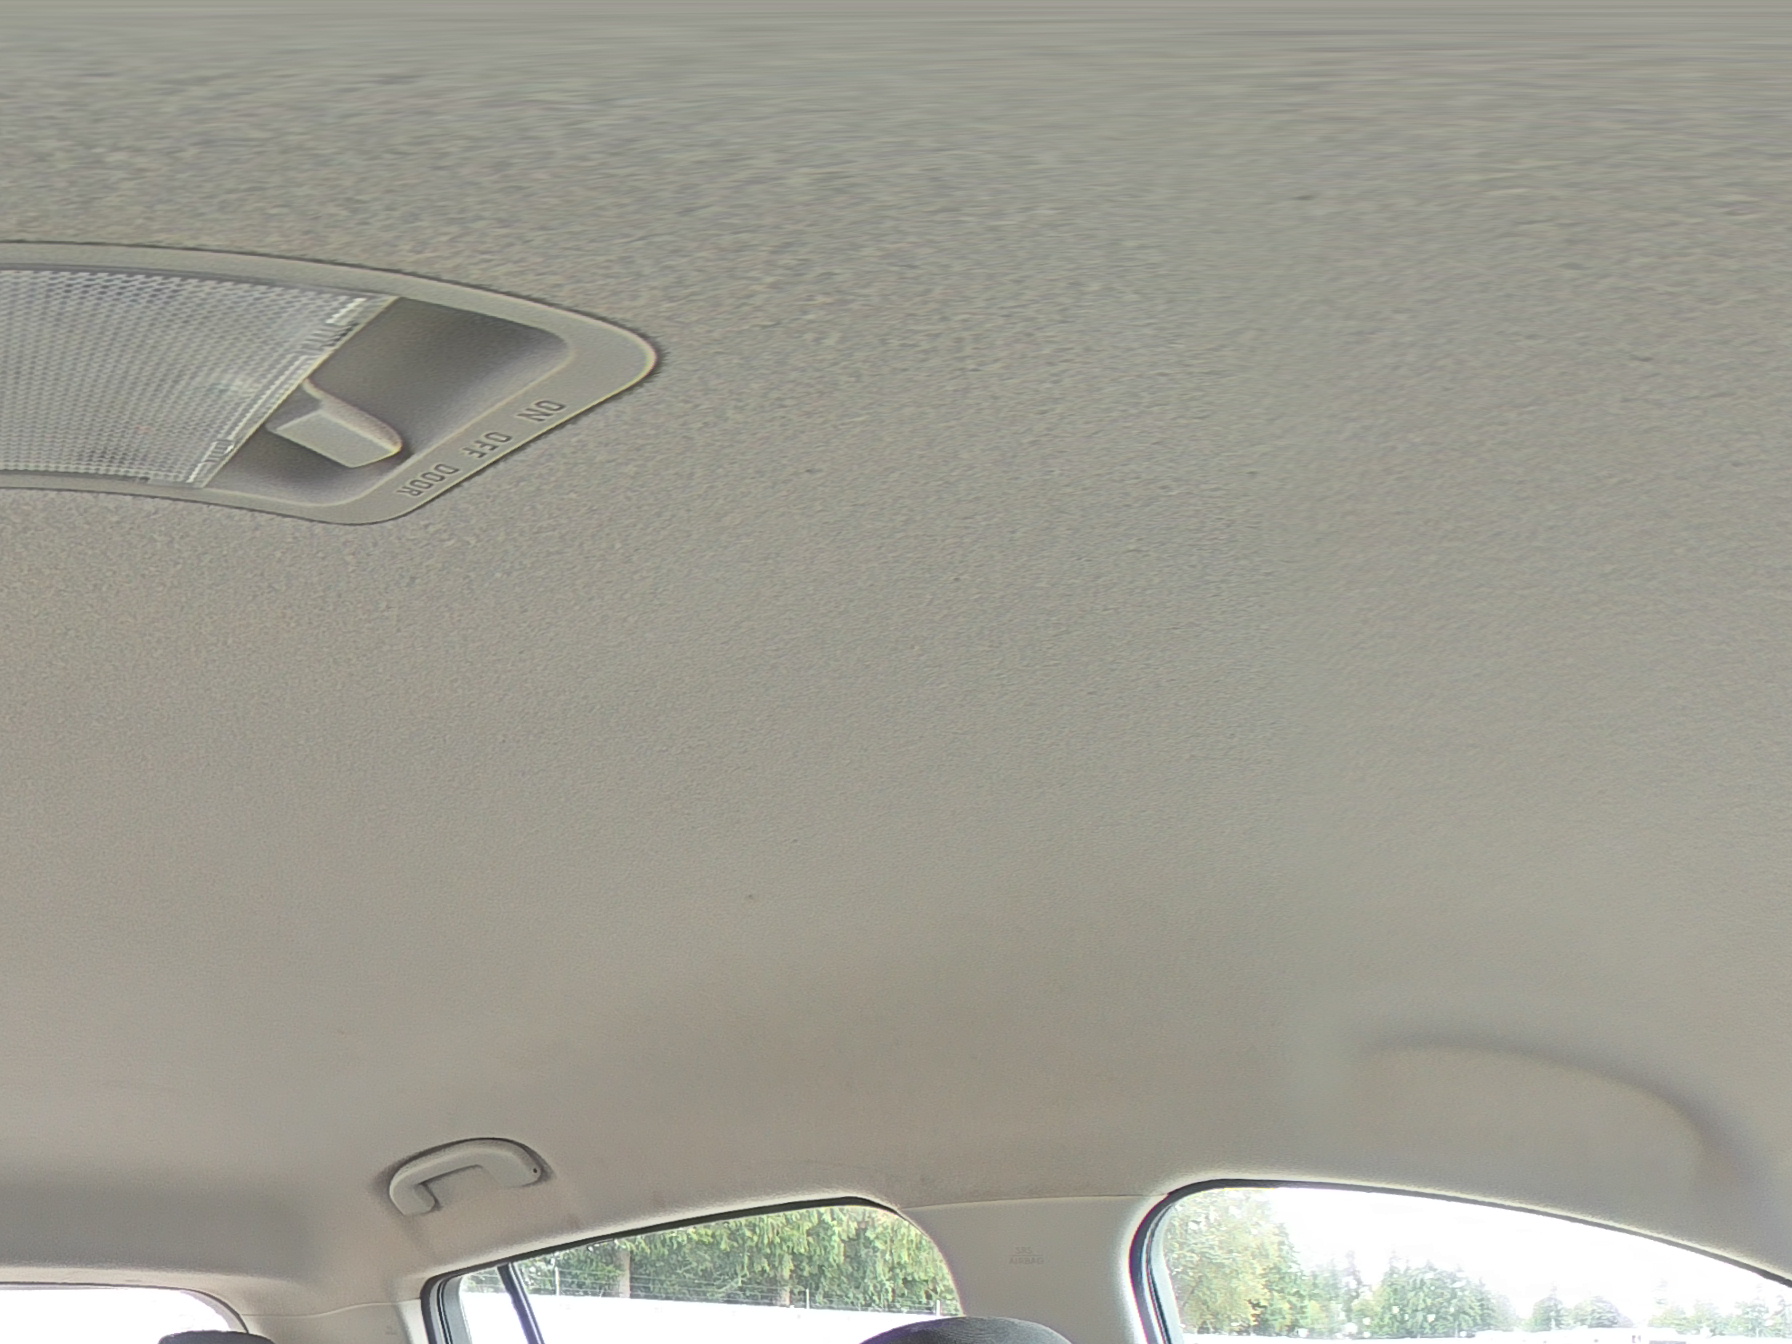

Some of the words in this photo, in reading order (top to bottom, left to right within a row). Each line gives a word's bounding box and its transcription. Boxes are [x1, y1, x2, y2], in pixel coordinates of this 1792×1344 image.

[516, 399, 567, 422] ON
[462, 431, 513, 459] OFF
[397, 463, 461, 497] DOOR
